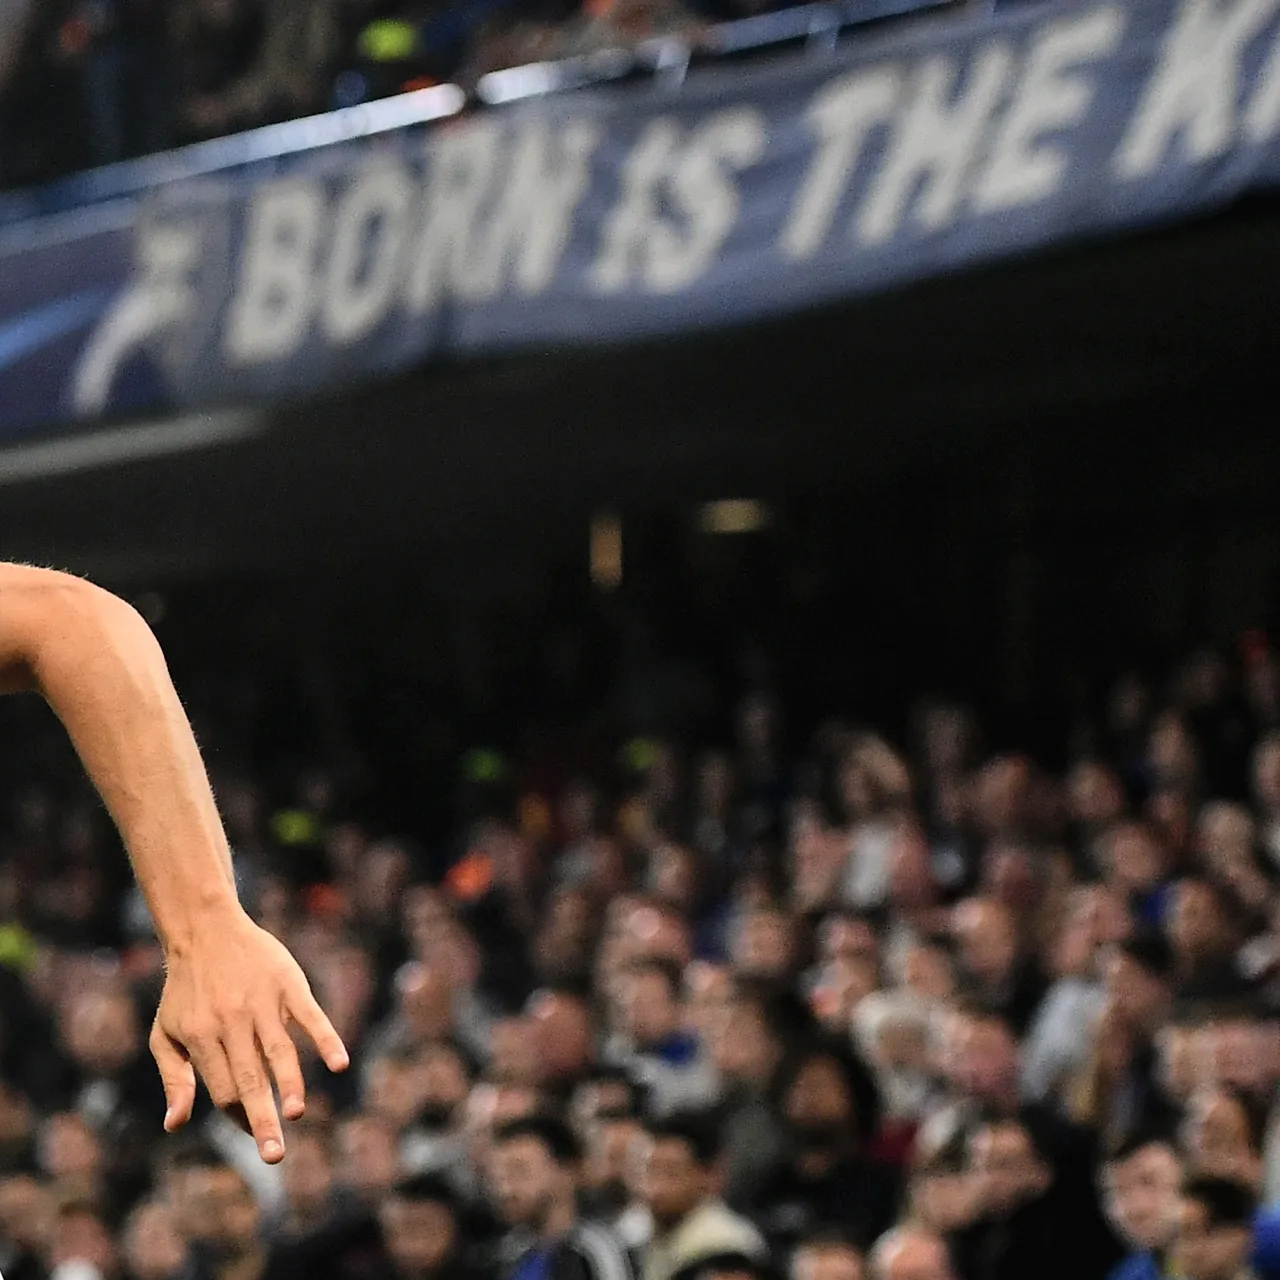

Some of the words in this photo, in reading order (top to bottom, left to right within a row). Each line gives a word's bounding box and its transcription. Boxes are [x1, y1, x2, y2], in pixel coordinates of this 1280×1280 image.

[226, 112, 602, 368] BORN
[588, 106, 766, 296] IS
[778, 6, 1130, 260] THE
